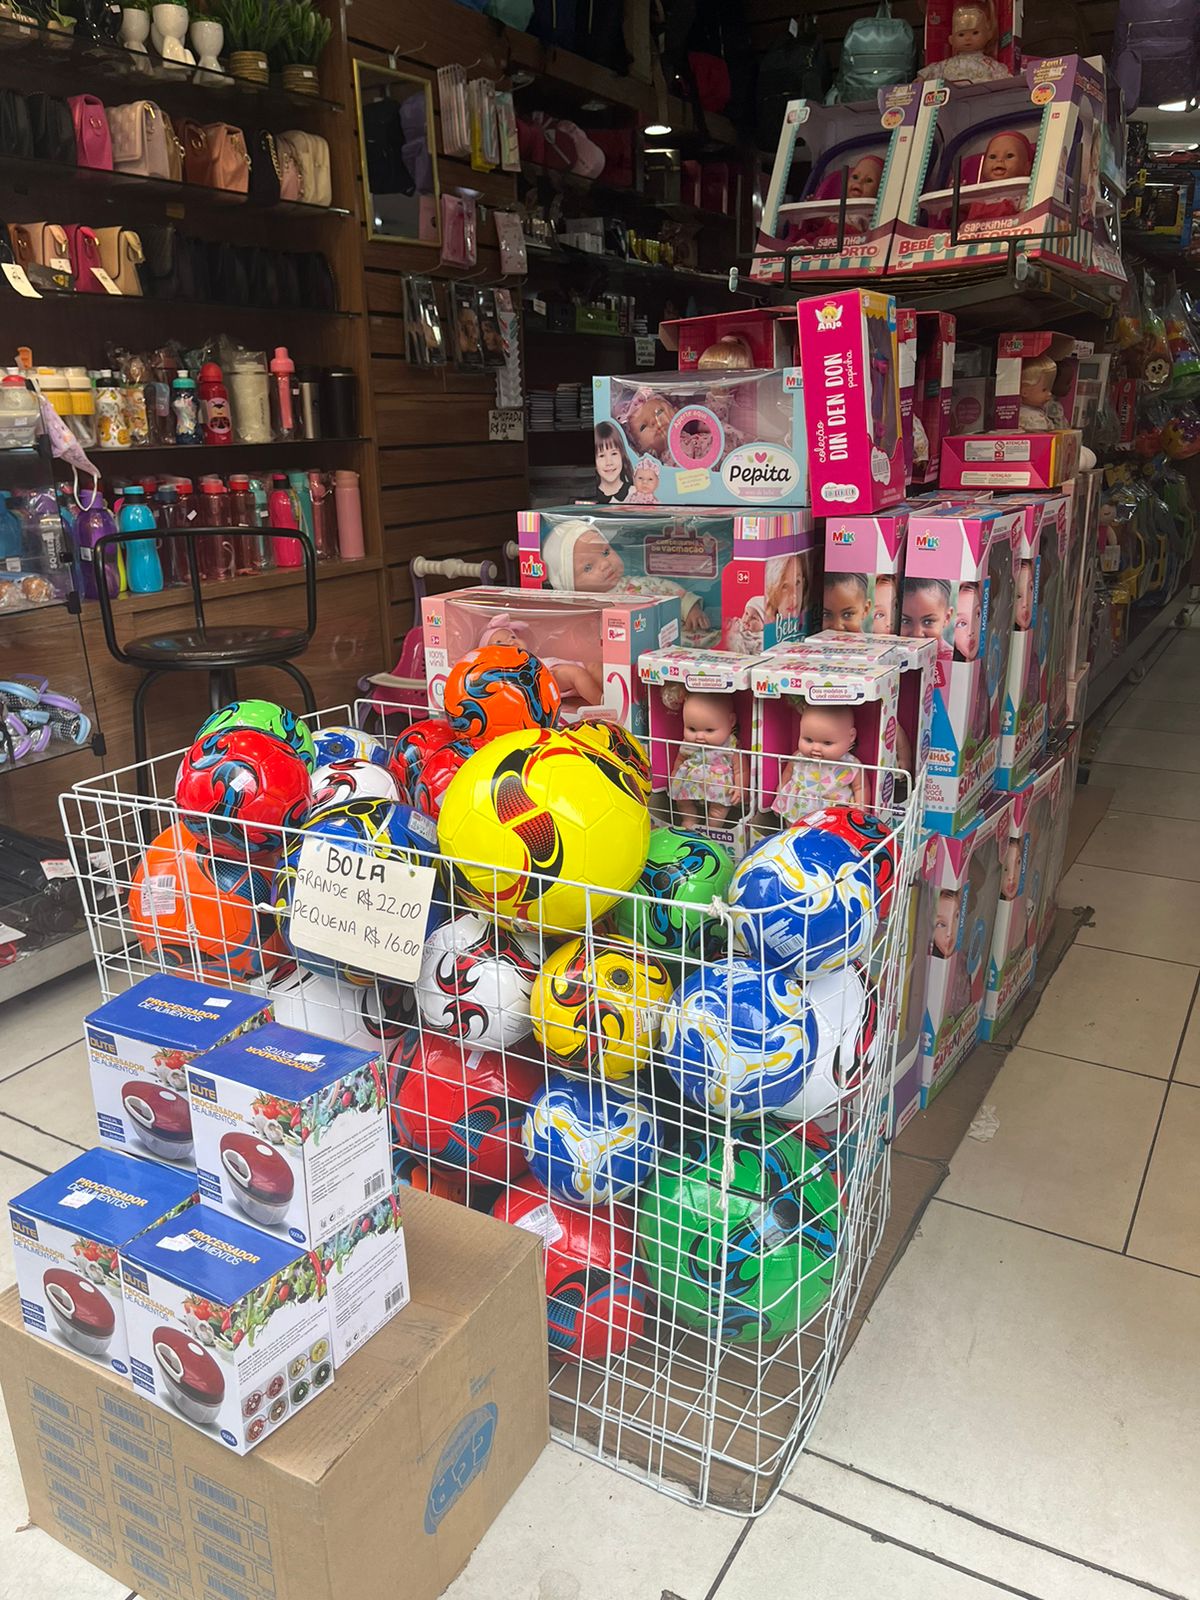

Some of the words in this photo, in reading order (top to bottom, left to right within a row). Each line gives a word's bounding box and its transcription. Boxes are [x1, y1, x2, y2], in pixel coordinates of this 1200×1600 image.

[823, 353, 844, 388] DON
[843, 348, 858, 388] papinha
[826, 393, 846, 427] DEN
[828, 432, 849, 461] DIN
[729, 463, 792, 486] Pepita
[981, 587, 990, 631] MODELOS
[326, 846, 386, 883] BOLA
[296, 868, 348, 899] GRANDE
[357, 888, 373, 911] R$
[376, 893, 422, 919] 22.00
[293, 899, 356, 935] PEQUENA
[364, 925, 380, 948] R$
[384, 932, 420, 957] 16.00
[137, 1001, 151, 1010] DE
[150, 1003, 204, 1022] ALIMENTOS
[143, 997, 221, 1020] PROCESSADOR
[90, 1050, 145, 1073] PROCESSADOR
[91, 1056, 102, 1066] DE
[101, 1058, 139, 1077] ALIMENTOS
[245, 1045, 319, 1074] PROCESSADOR
[191, 1098, 245, 1122] PROCESSADOR
[191, 1104, 202, 1114] DE
[201, 1107, 238, 1127] ALIMENTOS
[67, 1182, 80, 1192] DE
[76, 1177, 149, 1207] PROCESSADOR
[13, 1233, 66, 1260] PROCESSADOR
[14, 1239, 24, 1249] DE
[22, 1241, 60, 1265] ALIMENTOS
[188, 1228, 261, 1265] PROCESSADOR
[124, 1287, 176, 1319] PROCESSADOR
[125, 1292, 135, 1304] DE
[133, 1296, 169, 1322] ALIMENTOS
